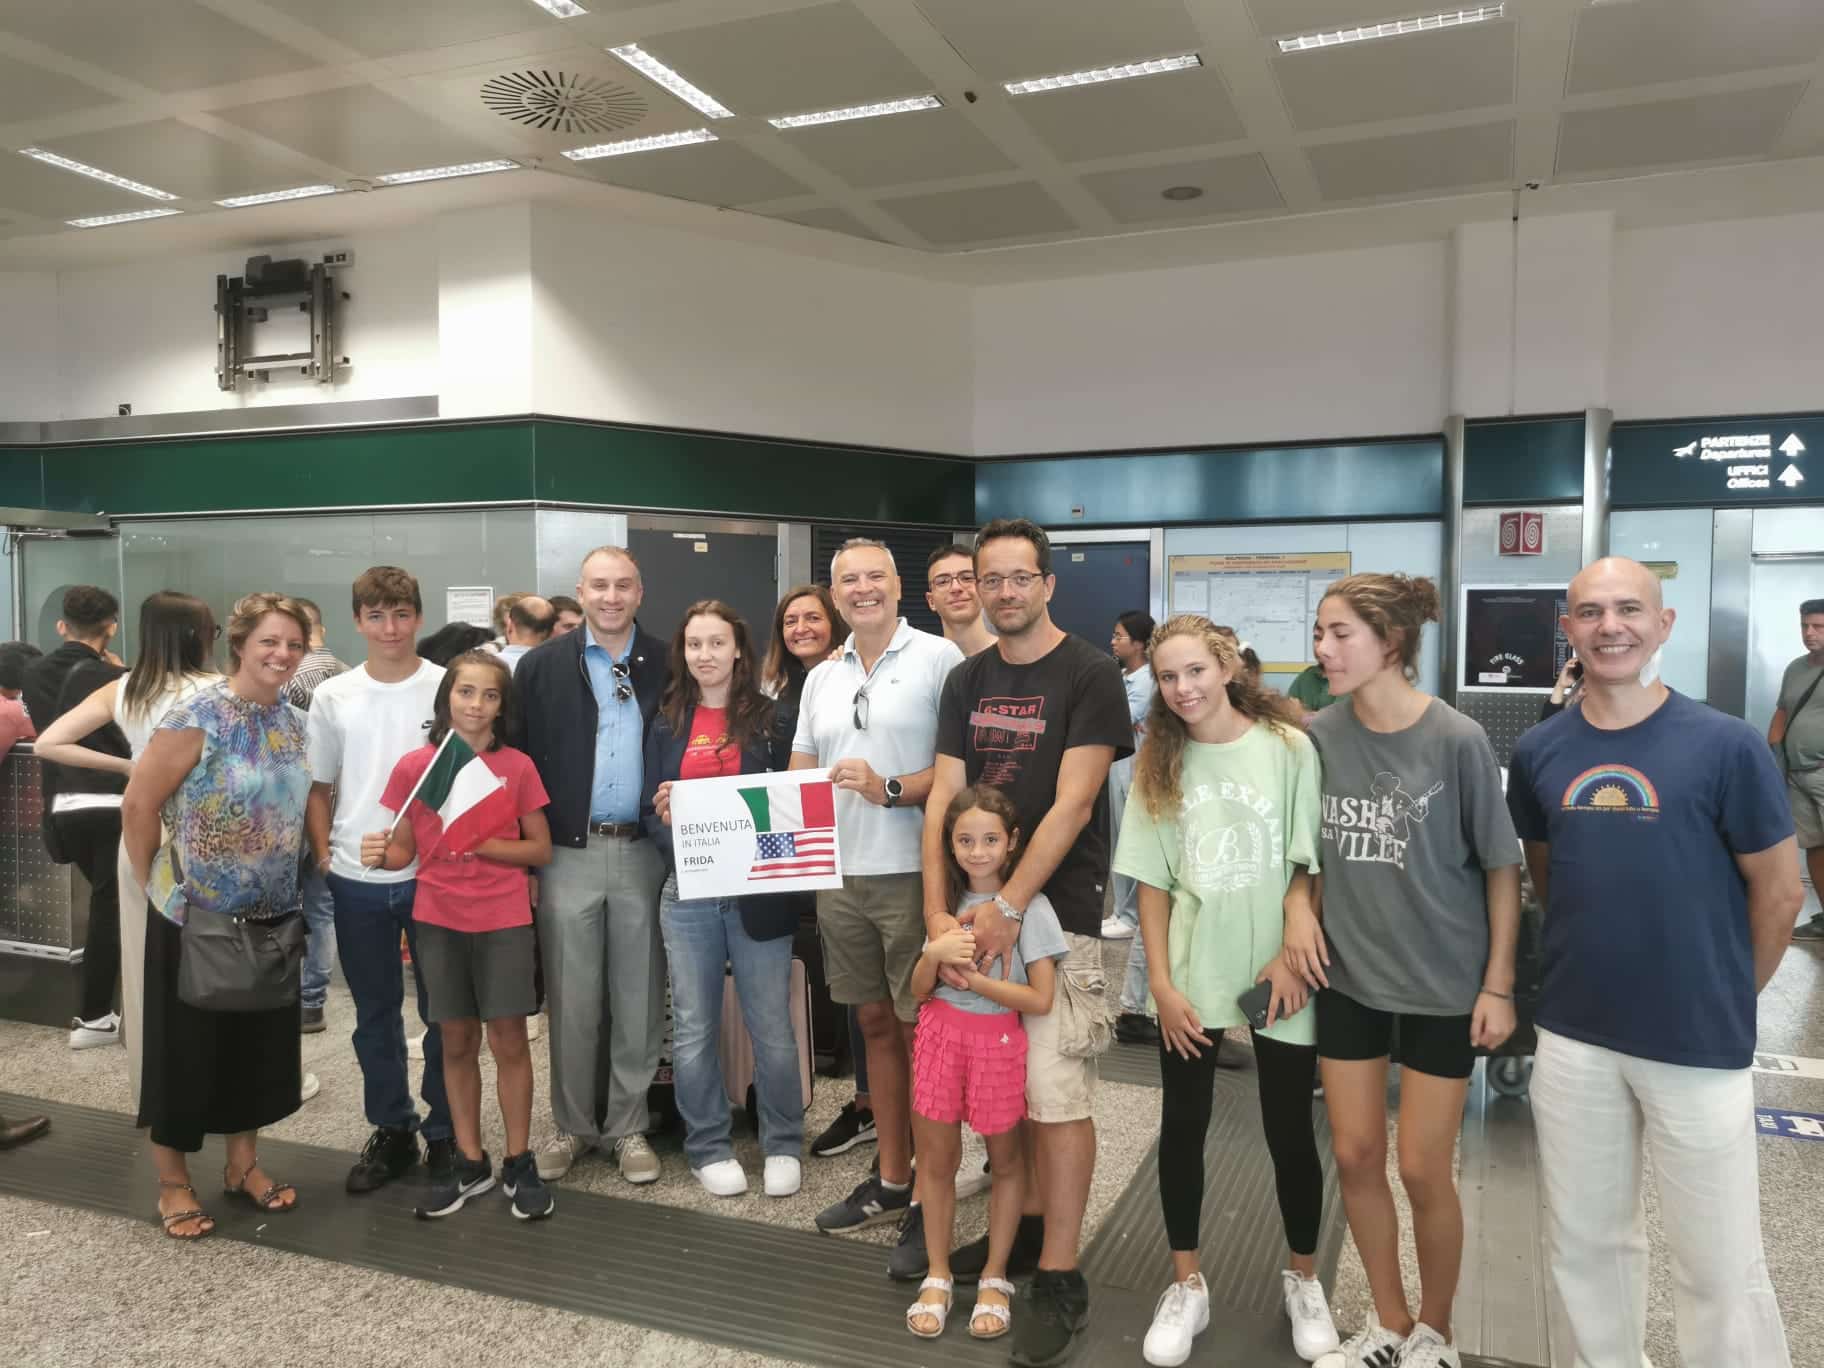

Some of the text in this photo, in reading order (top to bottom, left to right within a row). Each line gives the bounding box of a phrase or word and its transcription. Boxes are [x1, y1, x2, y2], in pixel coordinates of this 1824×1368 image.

[1701, 434, 1771, 448] PARTENZE
[1700, 448, 1771, 461] Departures
[1727, 464, 1769, 476] UFFICI
[1727, 477, 1770, 489] Offices
[680, 819, 753, 836] BENVENUTA
[682, 837, 721, 849] IN ITALIA
[683, 855, 715, 867] FRIDA
